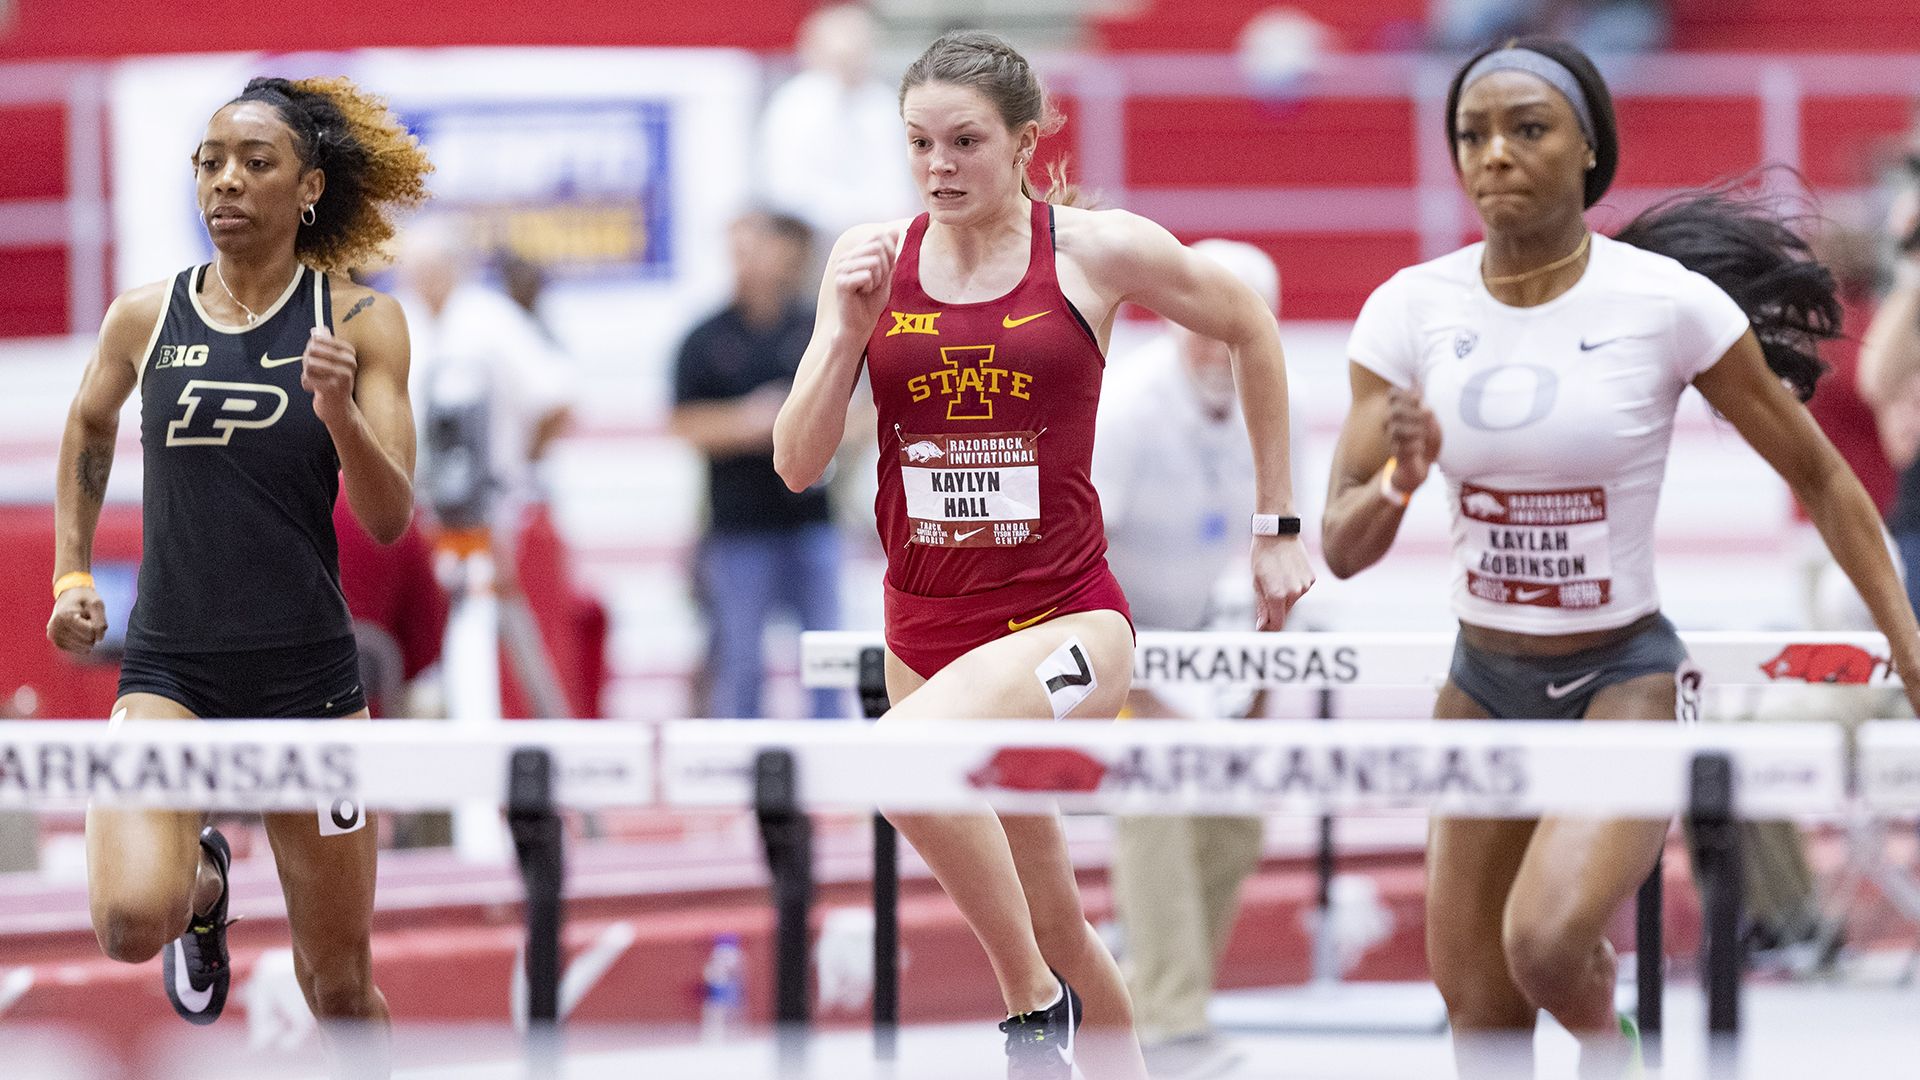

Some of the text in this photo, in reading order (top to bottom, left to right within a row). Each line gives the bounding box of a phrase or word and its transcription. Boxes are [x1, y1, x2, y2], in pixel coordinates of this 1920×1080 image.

[886, 311, 942, 337] XII
[907, 367, 1033, 403] STATE
[166, 380, 288, 447] P
[950, 437, 1023, 452] RAZORBACK
[950, 450, 1035, 465] INVITATIONAL
[931, 471, 1000, 493] KAYLYN
[944, 497, 990, 518] HALL
[920, 521, 943, 531] TRACK
[994, 522, 1029, 531] RANDAL
[920, 535, 945, 545] WORLD
[1046, 644, 1092, 694] 7
[1133, 646, 1359, 682] RKANSAS
[0, 745, 357, 792] ARKANSAS
